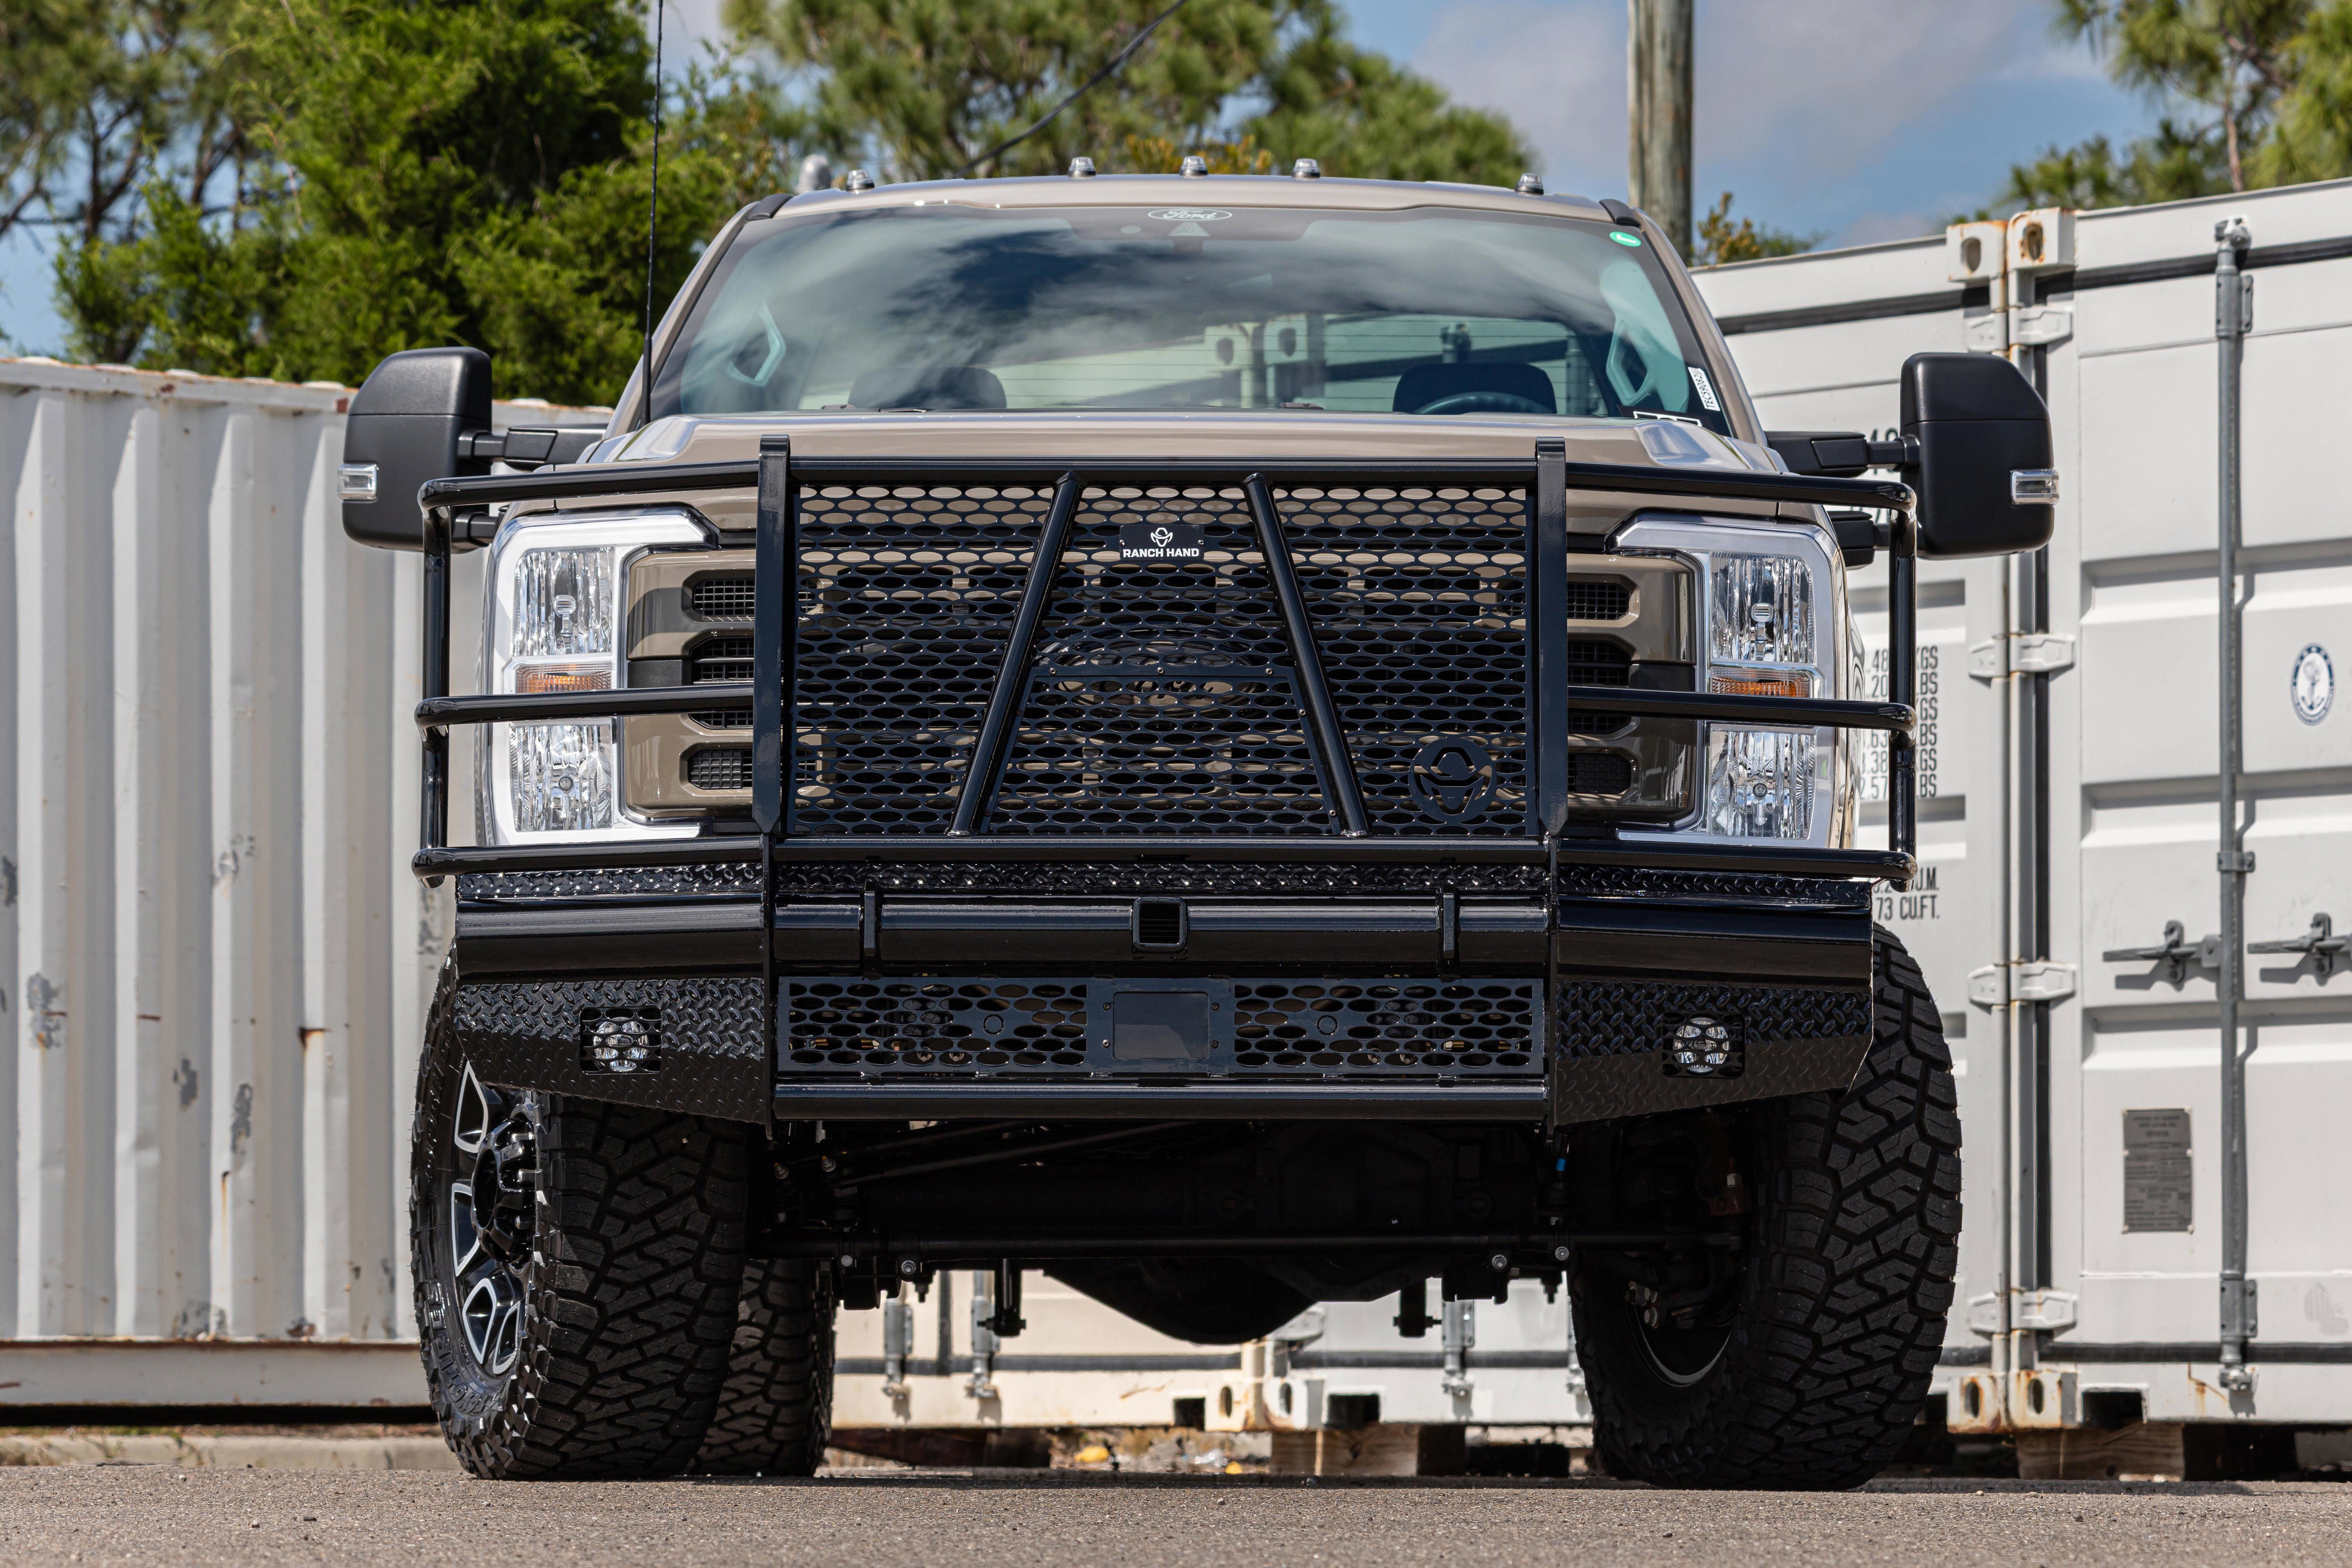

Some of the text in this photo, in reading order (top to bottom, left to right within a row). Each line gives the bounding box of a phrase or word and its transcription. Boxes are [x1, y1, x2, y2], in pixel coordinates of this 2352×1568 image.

[1163, 209, 1218, 219] Ford
[1123, 548, 1199, 558] RANCH HAND
[1916, 646, 1938, 670] GS
[1916, 672, 1938, 695] BS
[1916, 697, 1938, 721] GS
[1916, 723, 1937, 746] BS
[1916, 748, 1937, 772] GS
[1916, 774, 1937, 798] BS
[1875, 897, 1893, 921] 73
